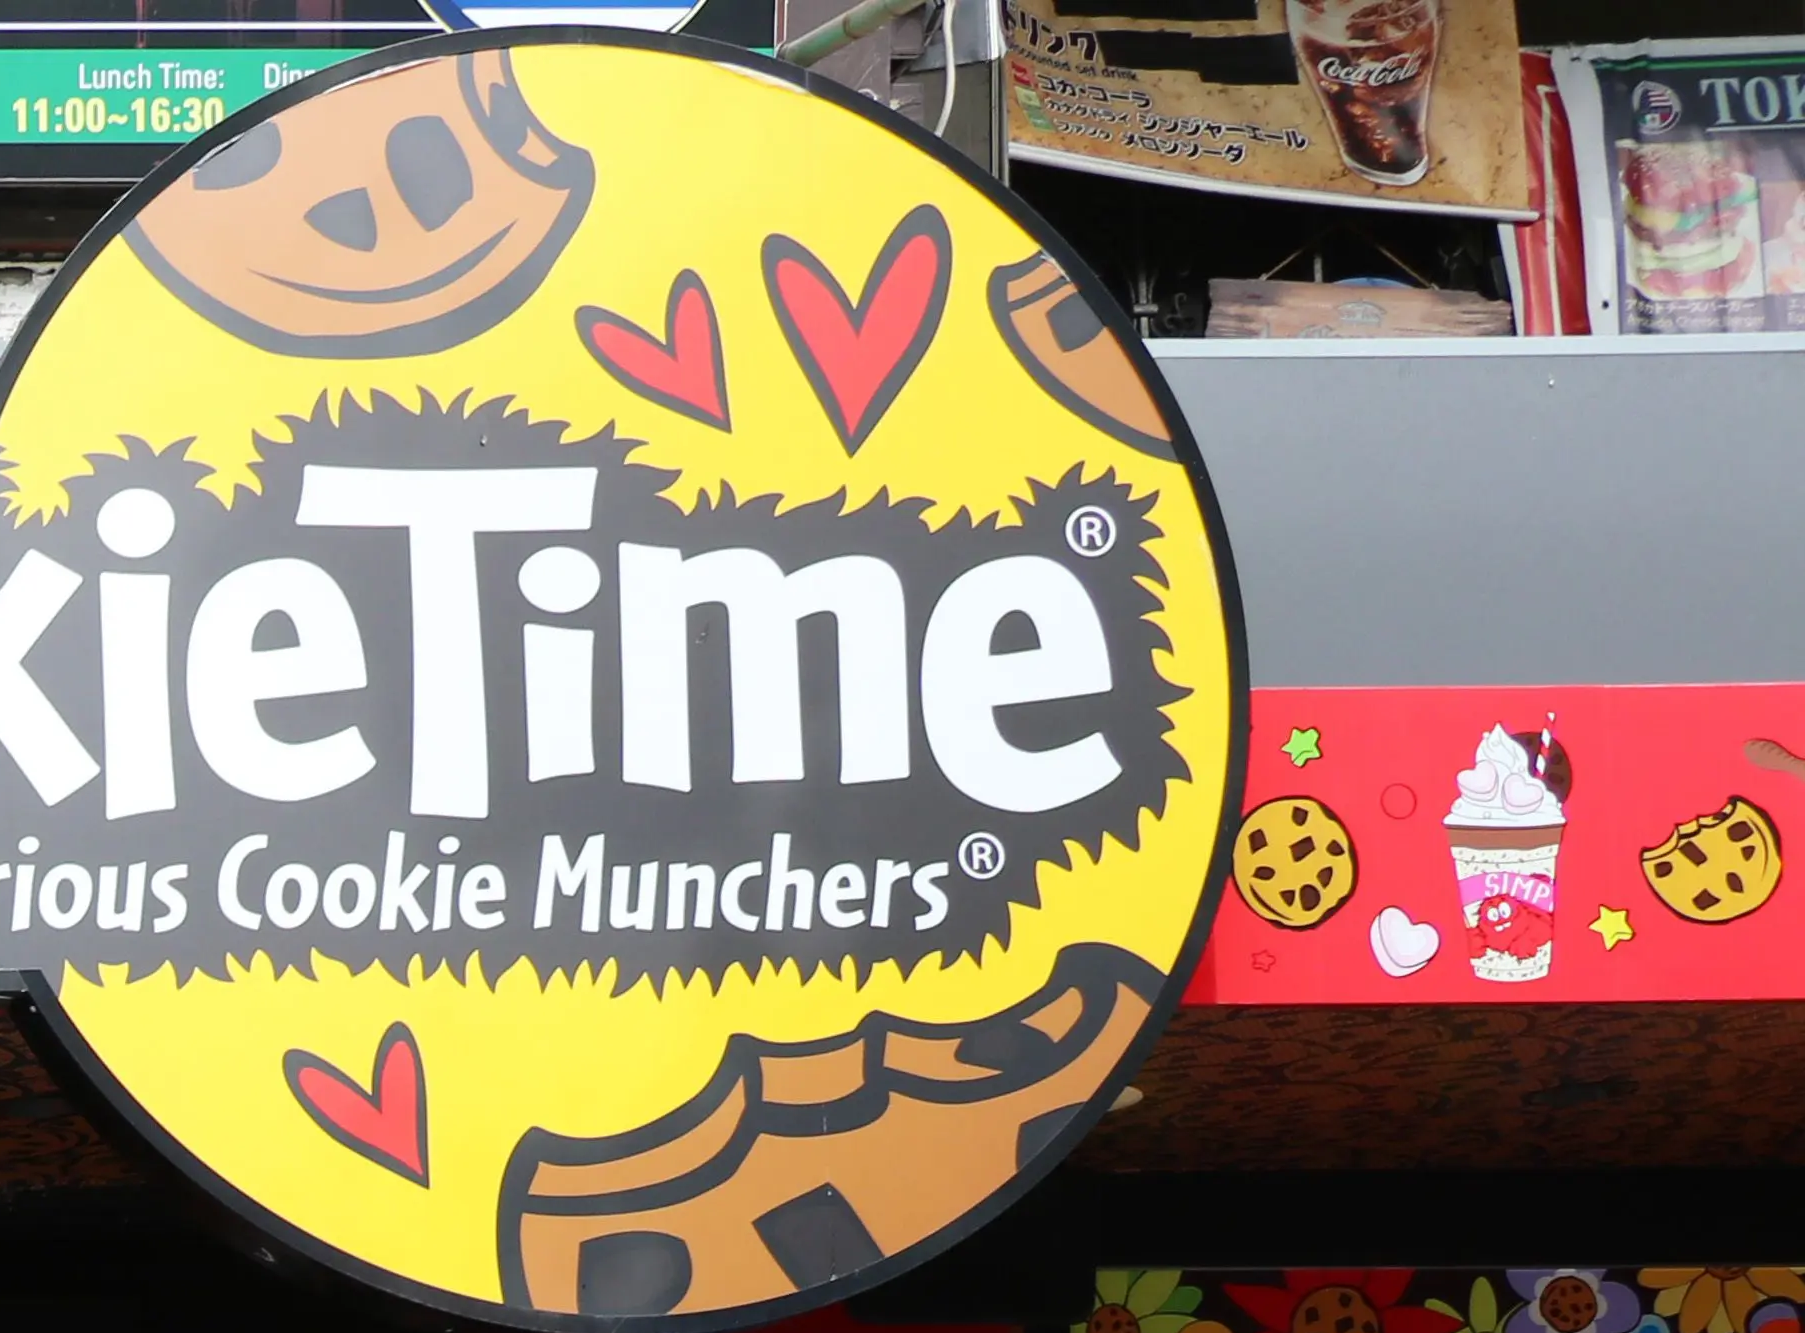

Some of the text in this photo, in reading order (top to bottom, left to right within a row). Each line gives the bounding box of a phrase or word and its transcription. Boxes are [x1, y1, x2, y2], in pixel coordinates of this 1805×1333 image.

[78, 62, 152, 90] Lunch
[158, 62, 225, 90] Time:
[12, 97, 225, 133] 11:00~16:30
[215, 831, 509, 934] Cookie
